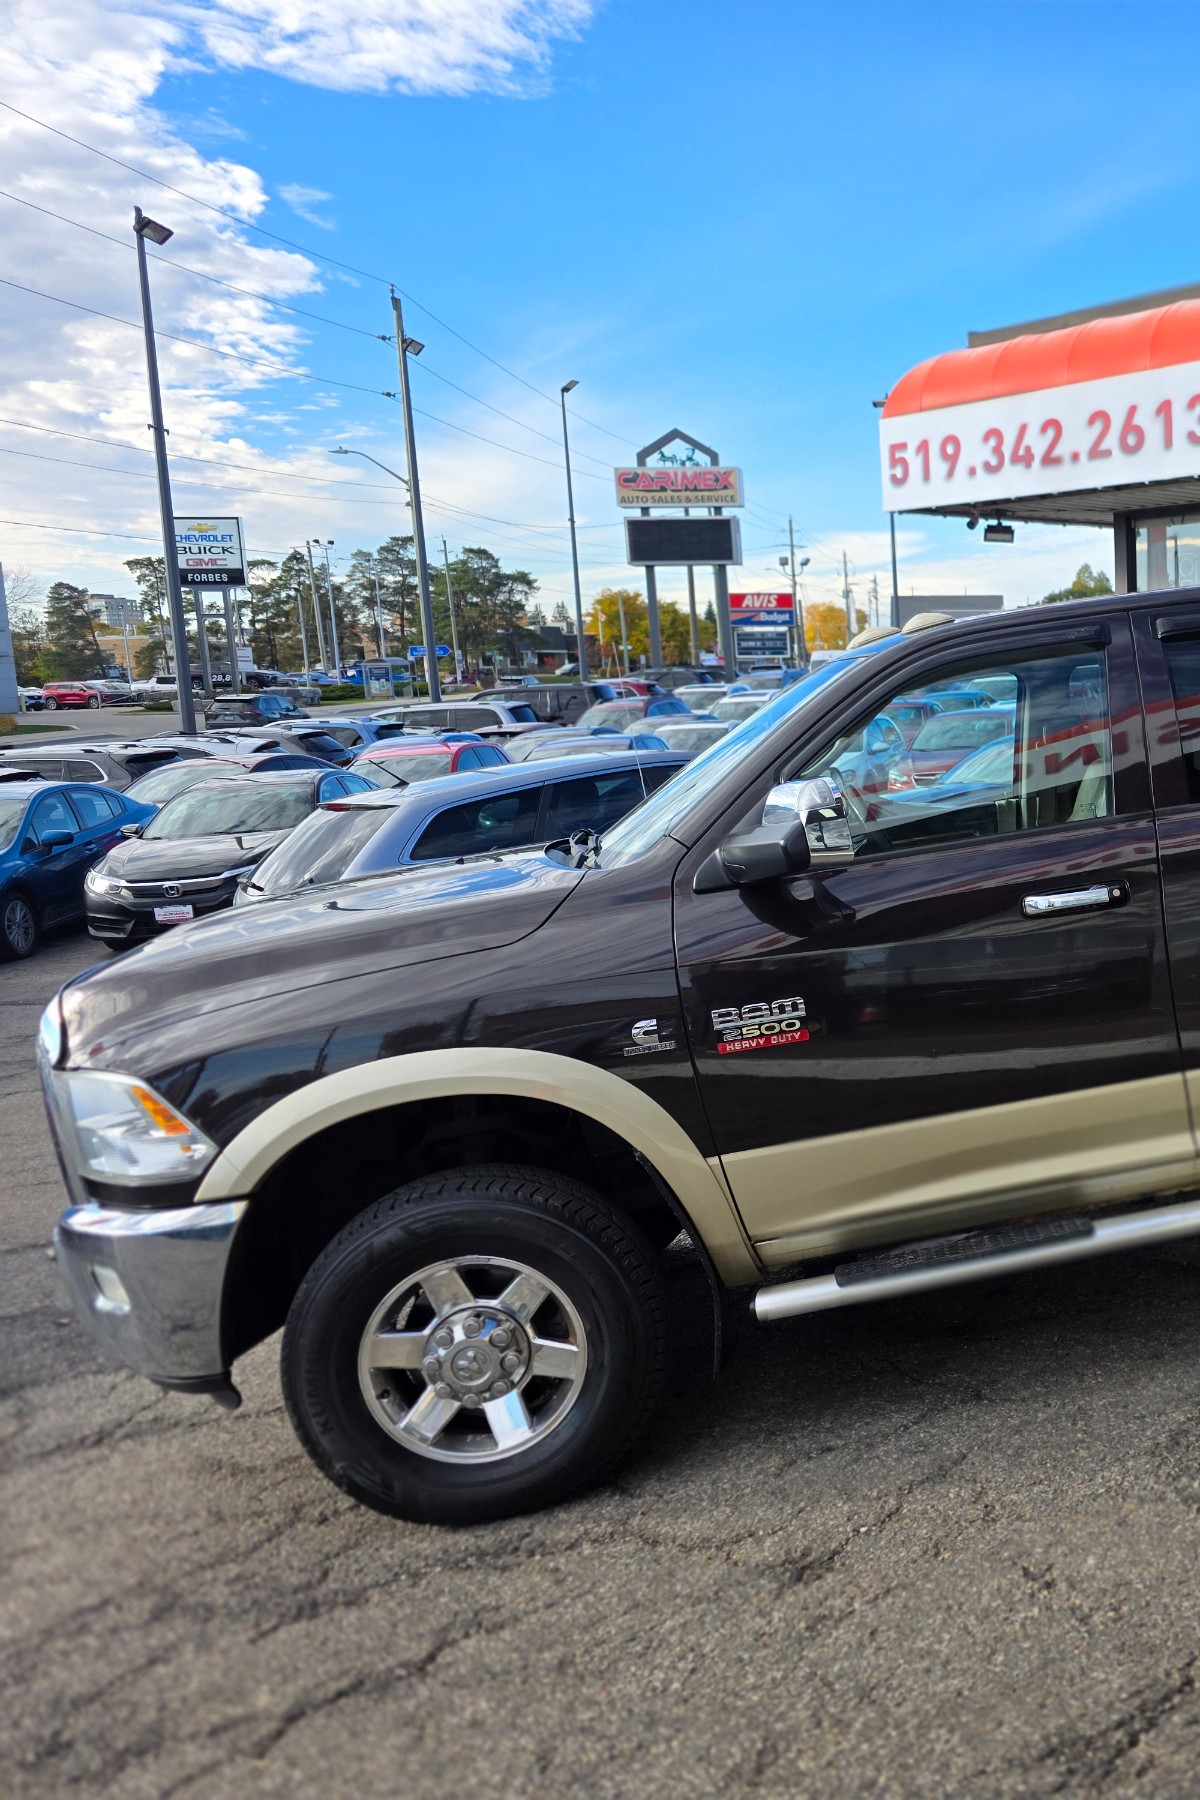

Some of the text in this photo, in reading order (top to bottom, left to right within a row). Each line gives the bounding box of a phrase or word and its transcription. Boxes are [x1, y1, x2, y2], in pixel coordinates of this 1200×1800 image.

[617, 470, 734, 490] CARIMEX
[620, 494, 736, 504] AUTO SALES & SERVICE
[186, 558, 228, 566] GMC
[187, 573, 228, 582] FORBES
[741, 594, 778, 608] AVIS
[760, 611, 790, 623] Budget
[711, 997, 806, 1029] RAM
[722, 1019, 801, 1041] 2500
[726, 1032, 801, 1051] HEAVY DUTY
